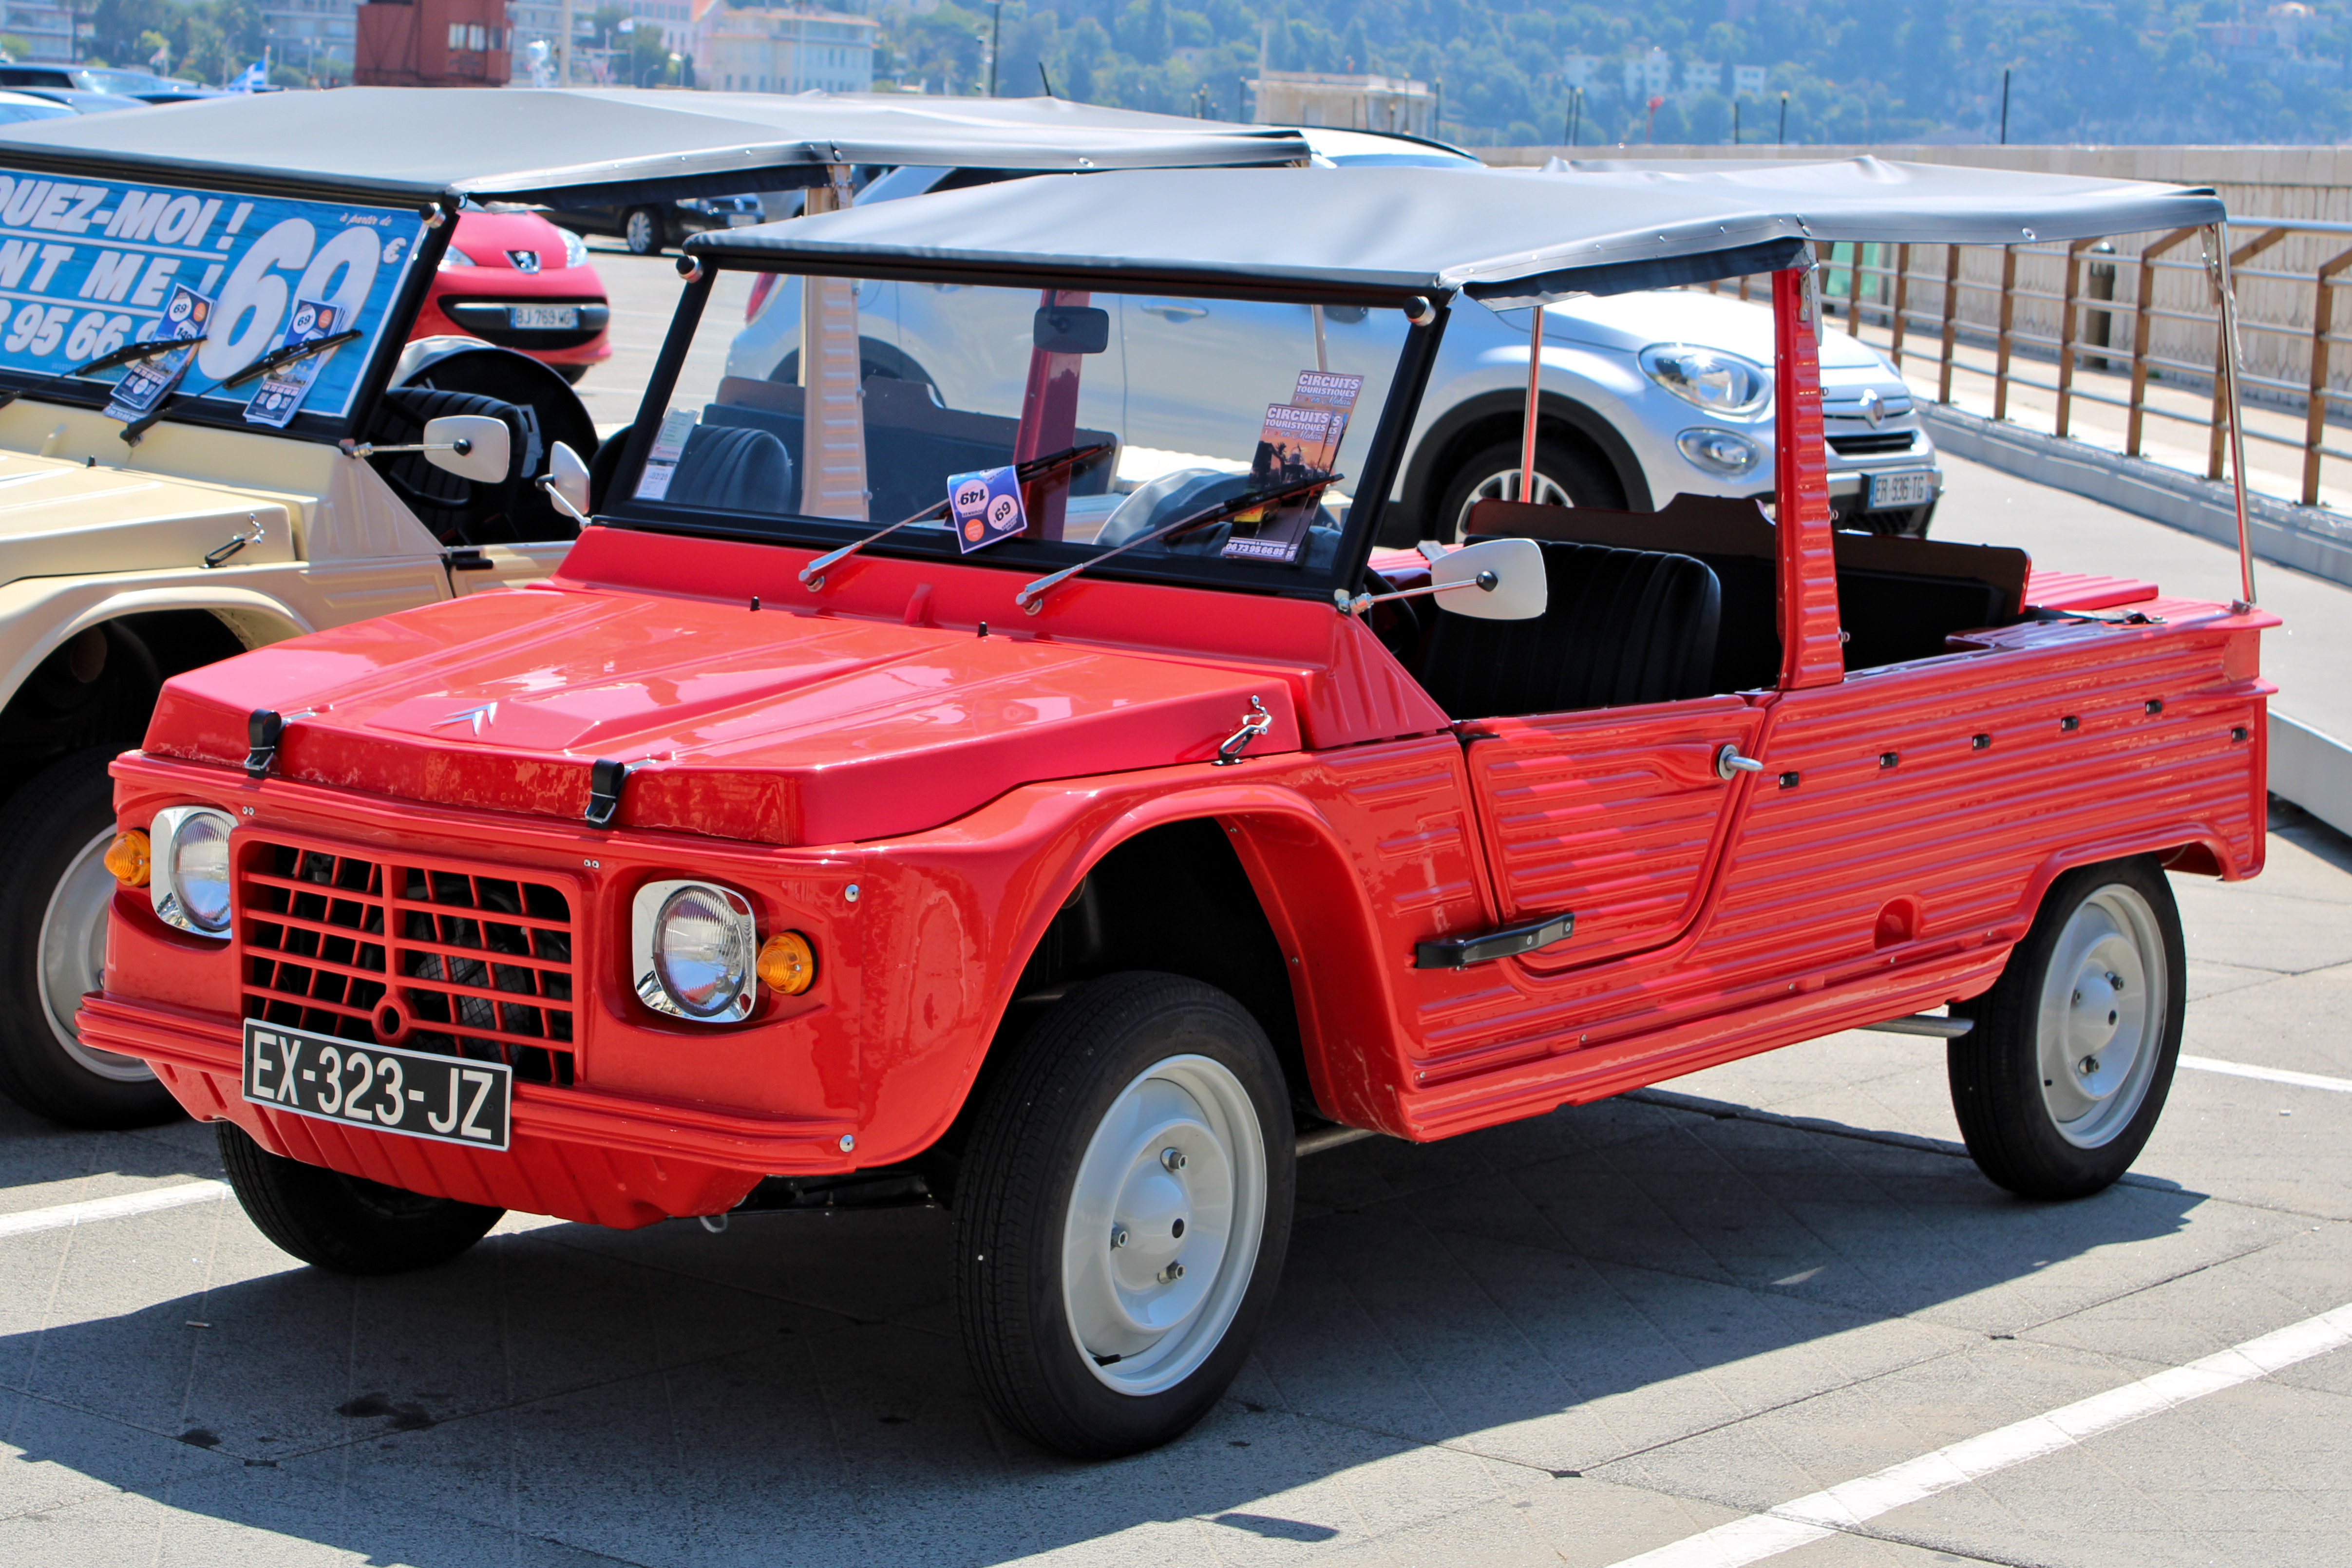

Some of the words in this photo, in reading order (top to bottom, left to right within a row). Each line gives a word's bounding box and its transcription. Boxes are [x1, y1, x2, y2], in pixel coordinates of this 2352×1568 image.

[78, 250, 181, 306] ME
[5, 304, 74, 356] 95
[65, 311, 132, 361] 66
[1299, 374, 1360, 389] CIRCUITS
[1296, 385, 1356, 397] TOURISTIQUES
[1267, 407, 1329, 424] CIRCUITS
[1265, 419, 1326, 432] TOURISTIQUES
[252, 1030, 493, 1140] EX-323-JZ
